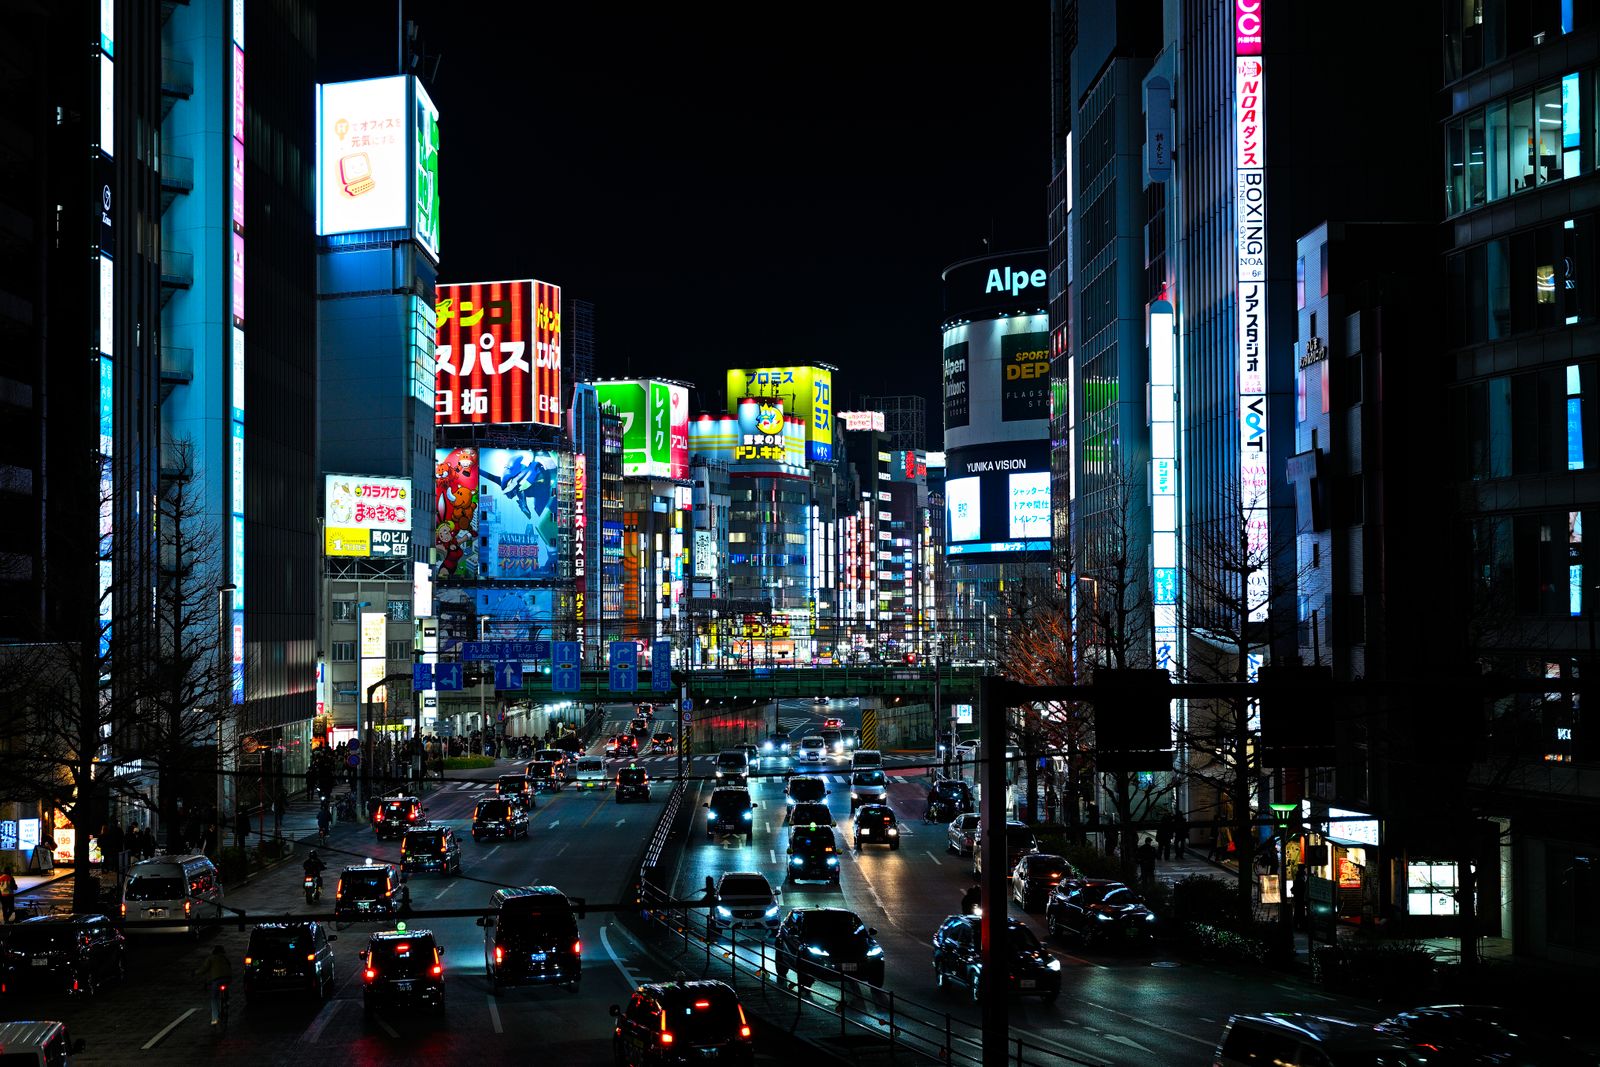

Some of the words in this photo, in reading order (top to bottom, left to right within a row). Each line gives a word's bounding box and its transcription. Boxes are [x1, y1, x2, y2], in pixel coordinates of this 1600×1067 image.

[1246, 173, 1263, 255] BOXING
[1240, 257, 1263, 266] NOA
[985, 266, 1046, 296] Alpe
[944, 357, 966, 380] Alpen
[745, 371, 794, 385] プロミス
[655, 386, 665, 451] レイク
[671, 434, 688, 450] アコム
[967, 461, 994, 472] YUNIKA
[995, 459, 1027, 471] VISION
[362, 484, 399, 499] カラオケ
[354, 499, 407, 524] まねきねこ
[574, 499, 585, 556] エスパス
[393, 545, 408, 555] 4F
[498, 557, 540, 571] インパクト
[469, 643, 501, 653] 九段下
